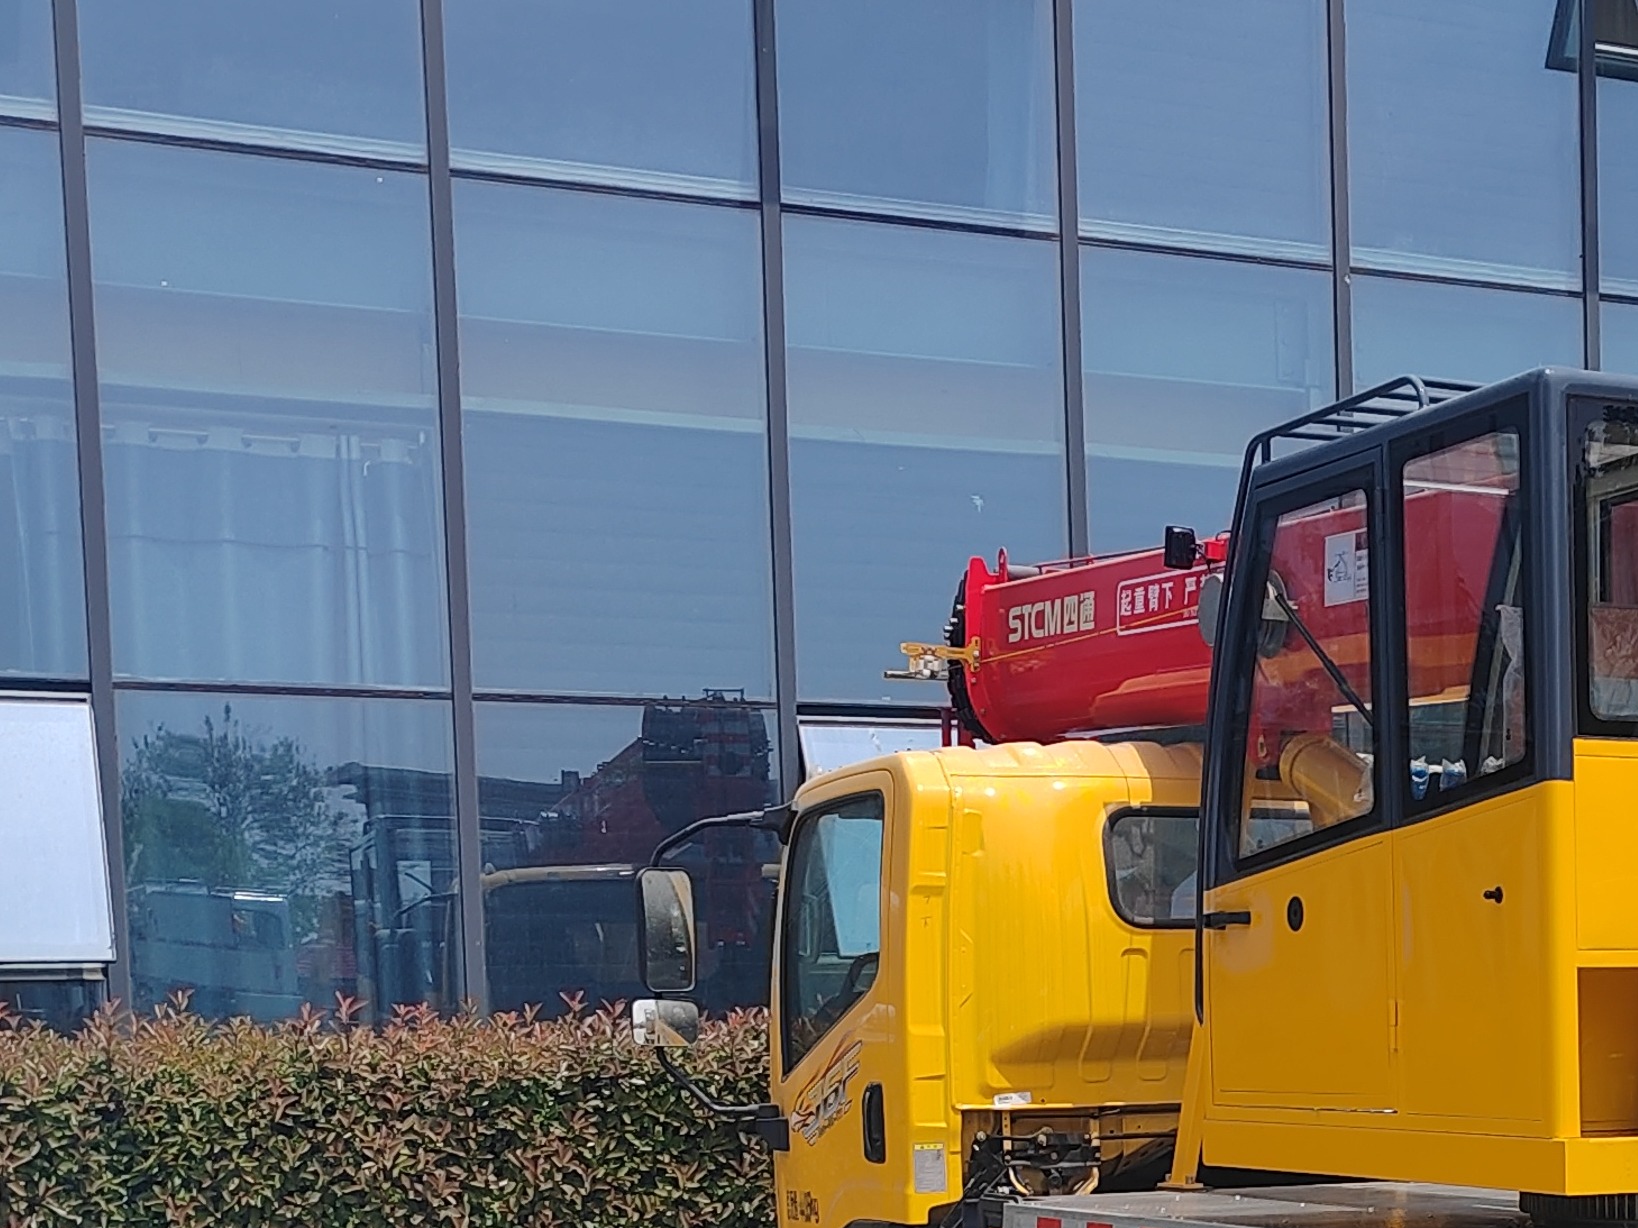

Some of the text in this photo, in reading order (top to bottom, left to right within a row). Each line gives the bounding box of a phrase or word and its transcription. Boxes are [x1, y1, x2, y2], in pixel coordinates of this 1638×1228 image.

[1008, 591, 1095, 643] STCM四通
[1120, 582, 1173, 616] 起重臂下
